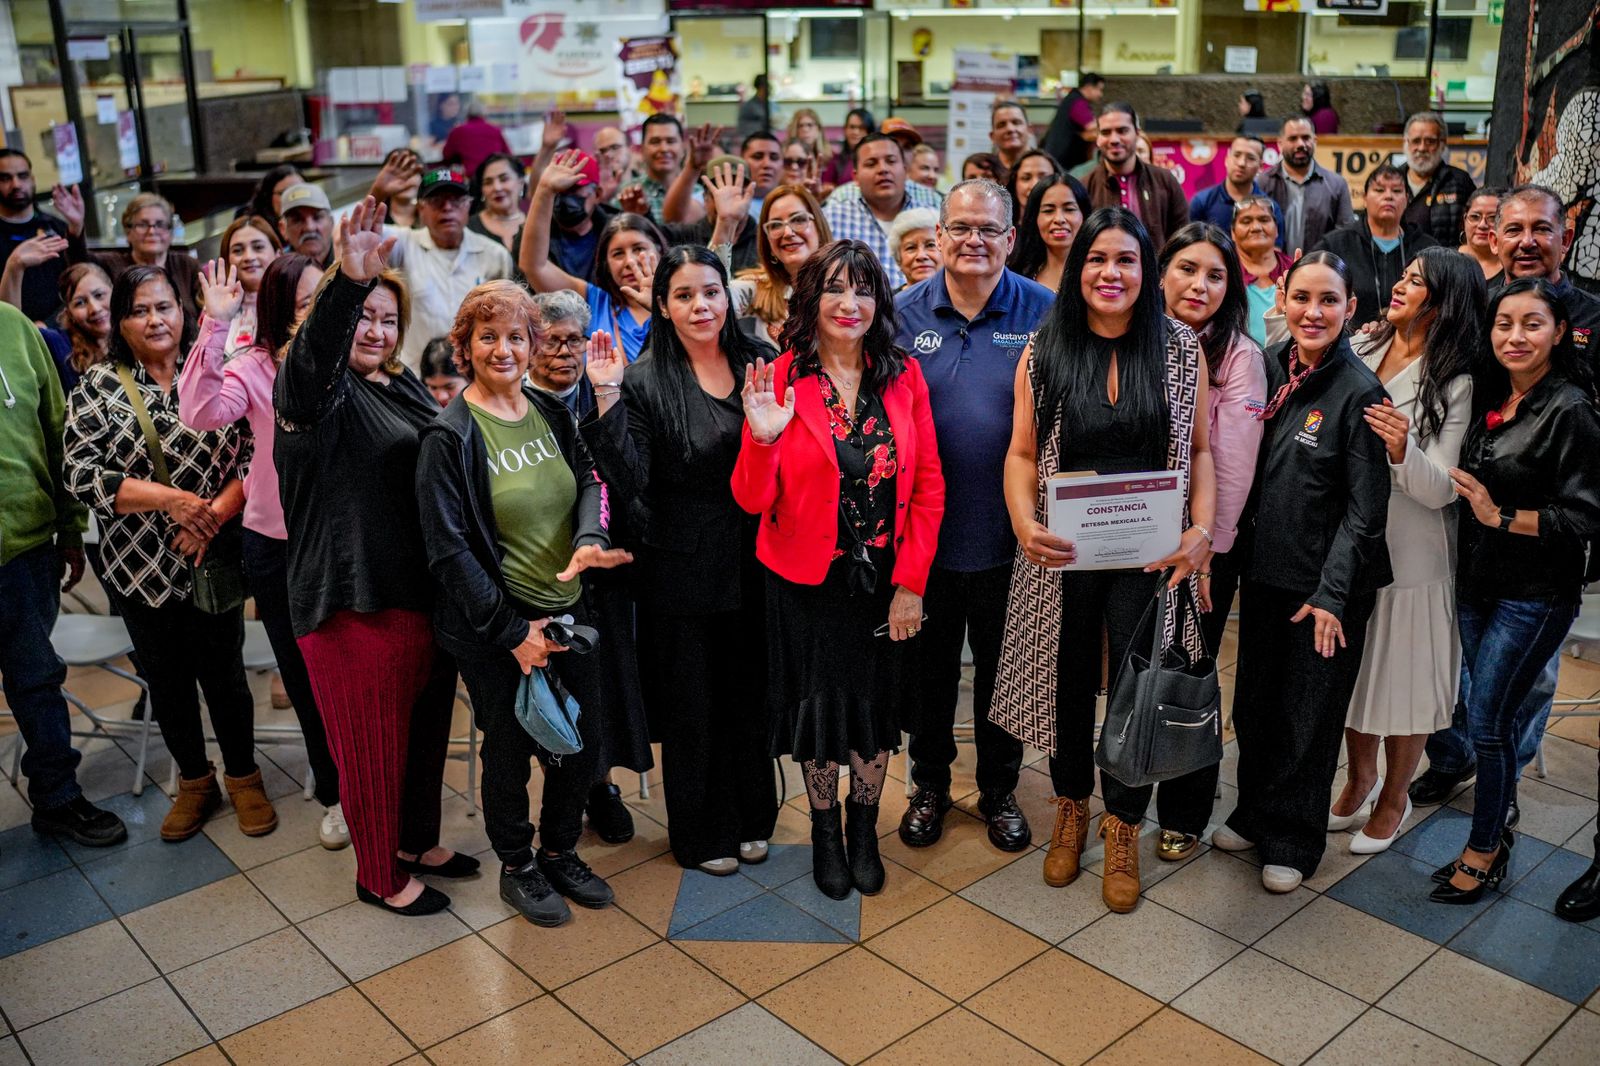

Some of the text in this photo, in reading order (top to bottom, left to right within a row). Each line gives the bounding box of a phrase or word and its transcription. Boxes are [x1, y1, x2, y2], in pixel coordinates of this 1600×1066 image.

[914, 336, 942, 348] PAN
[993, 332, 1028, 340] Gustavo
[1087, 503, 1147, 515] CONSTANCIA
